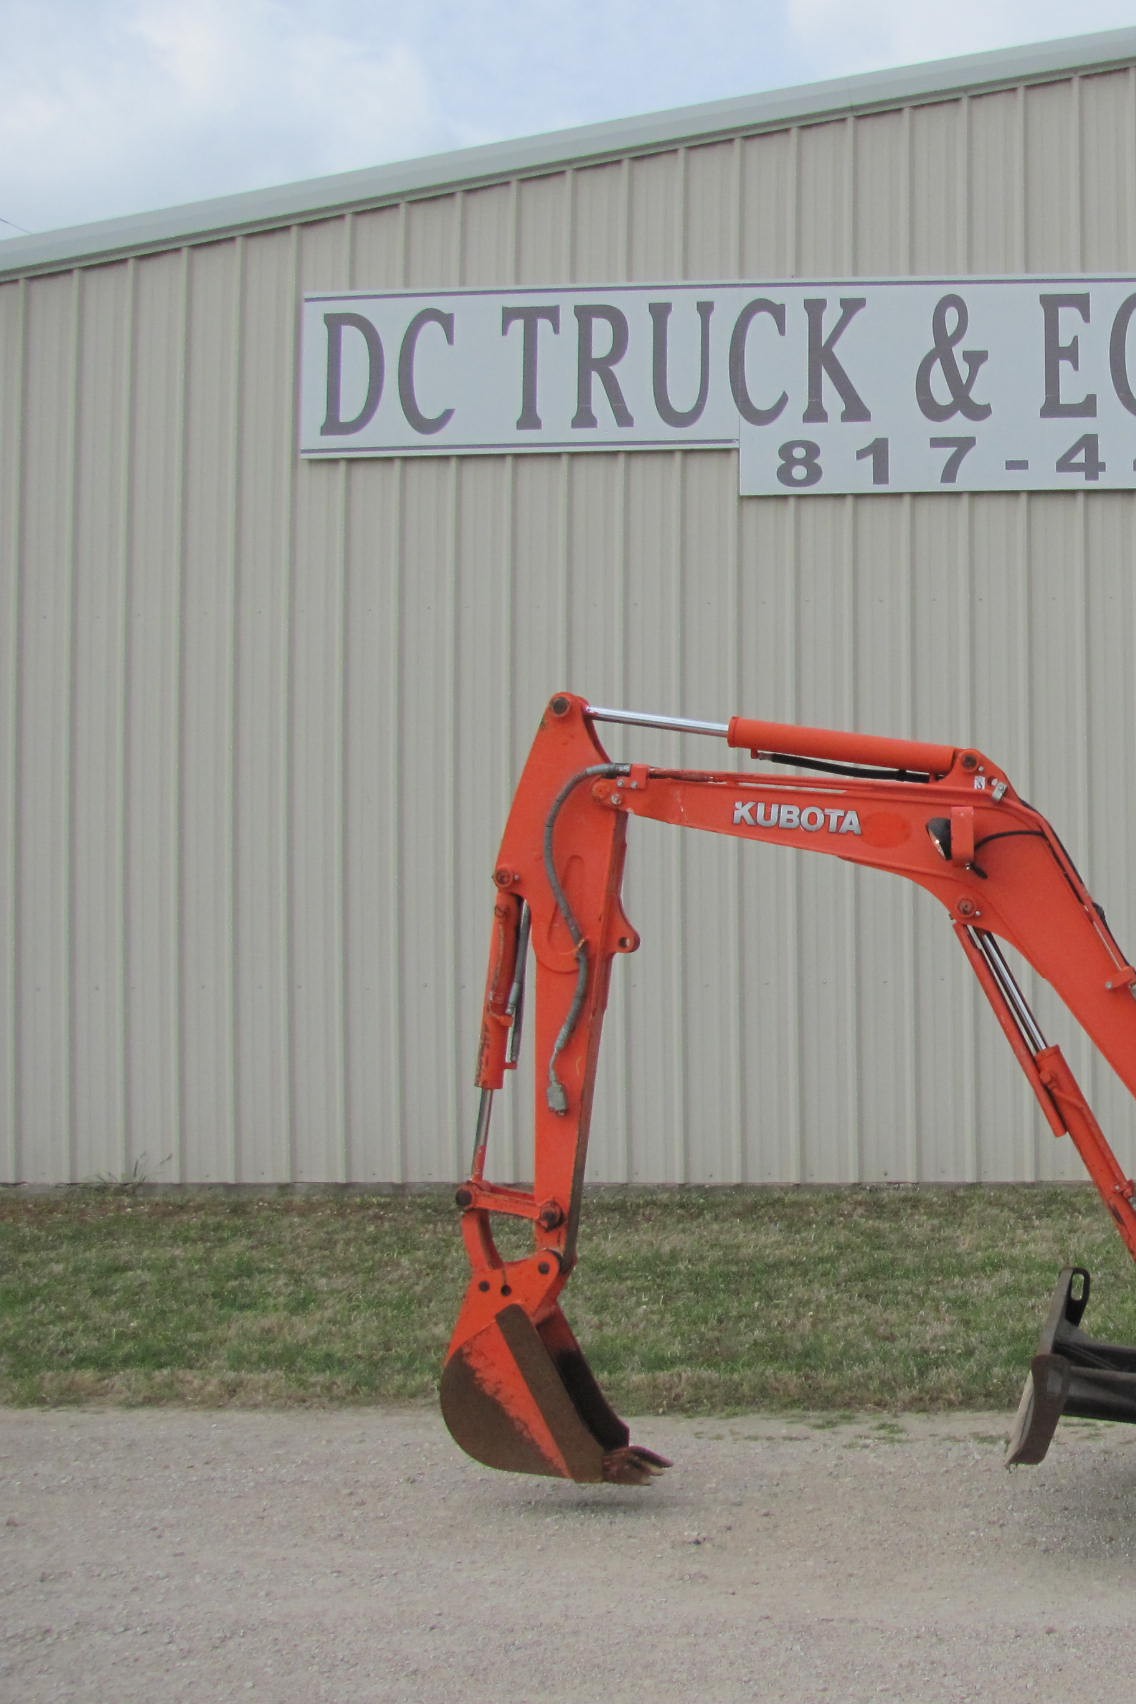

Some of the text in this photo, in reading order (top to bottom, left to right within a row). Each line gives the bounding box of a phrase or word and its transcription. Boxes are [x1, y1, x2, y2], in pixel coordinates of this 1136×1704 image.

[320, 307, 456, 436] DC
[501, 297, 872, 431] TRUCK
[915, 293, 993, 423] &
[732, 801, 862, 835] KUBOTA
